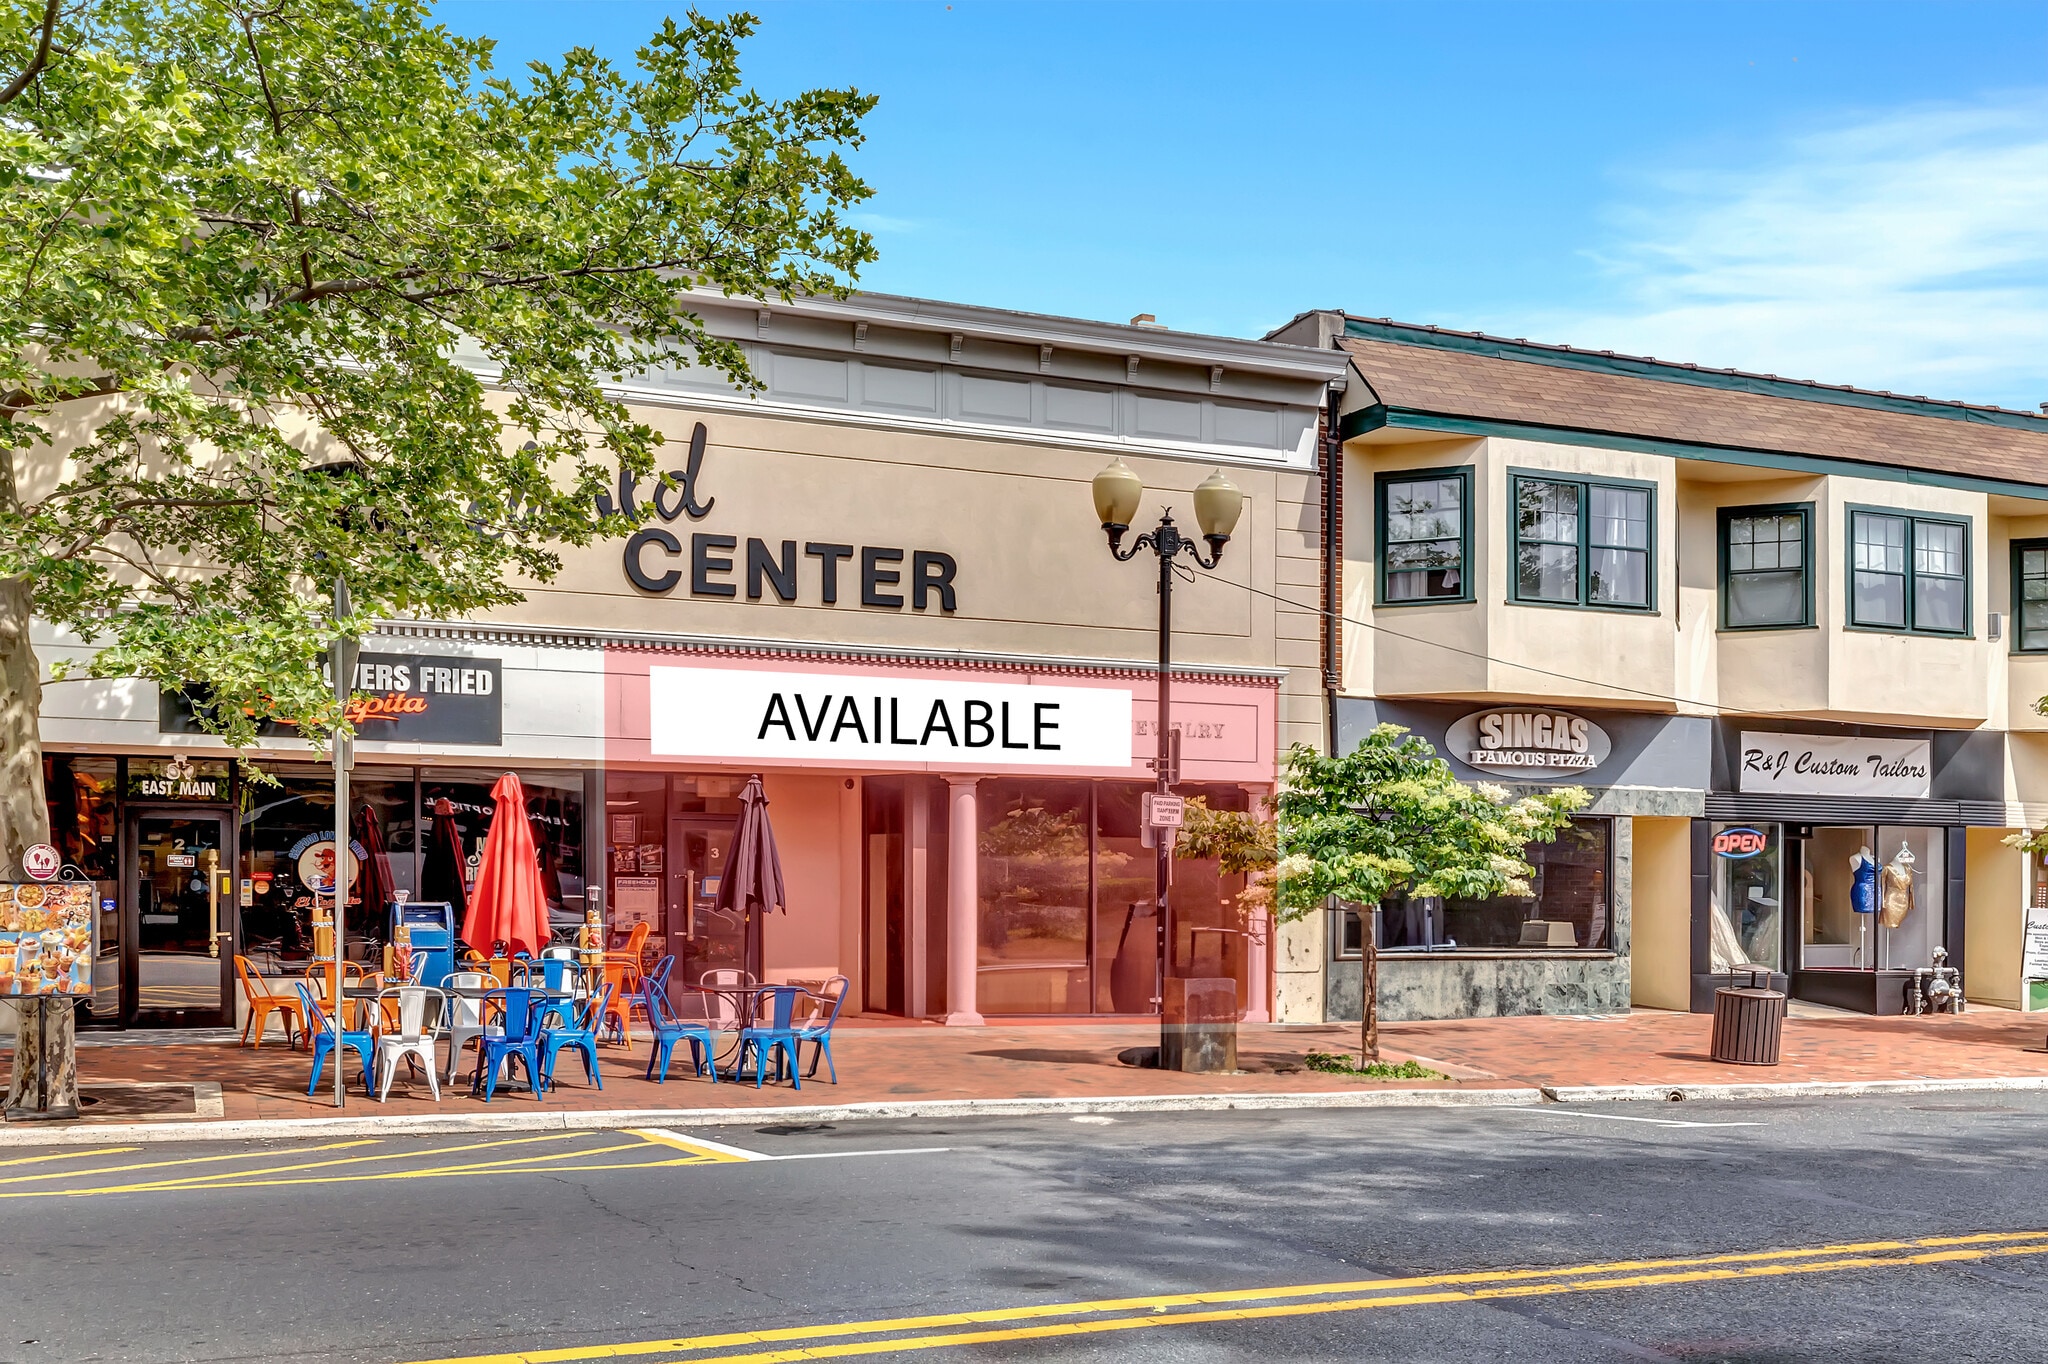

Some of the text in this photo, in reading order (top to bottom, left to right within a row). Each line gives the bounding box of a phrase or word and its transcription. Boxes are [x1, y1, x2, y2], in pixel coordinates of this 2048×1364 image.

[624, 527, 958, 611] CENTER
[419, 665, 493, 696] FRIED
[1479, 713, 1589, 754] SINGAS
[1470, 750, 1597, 768] FAMOUS PIZZA
[1743, 748, 1927, 780] R&J Custom Tailors
[142, 780, 216, 796] EAST MAIN
[174, 838, 185, 850] 2
[1713, 834, 1767, 852] OPEN
[710, 847, 720, 859] 3
